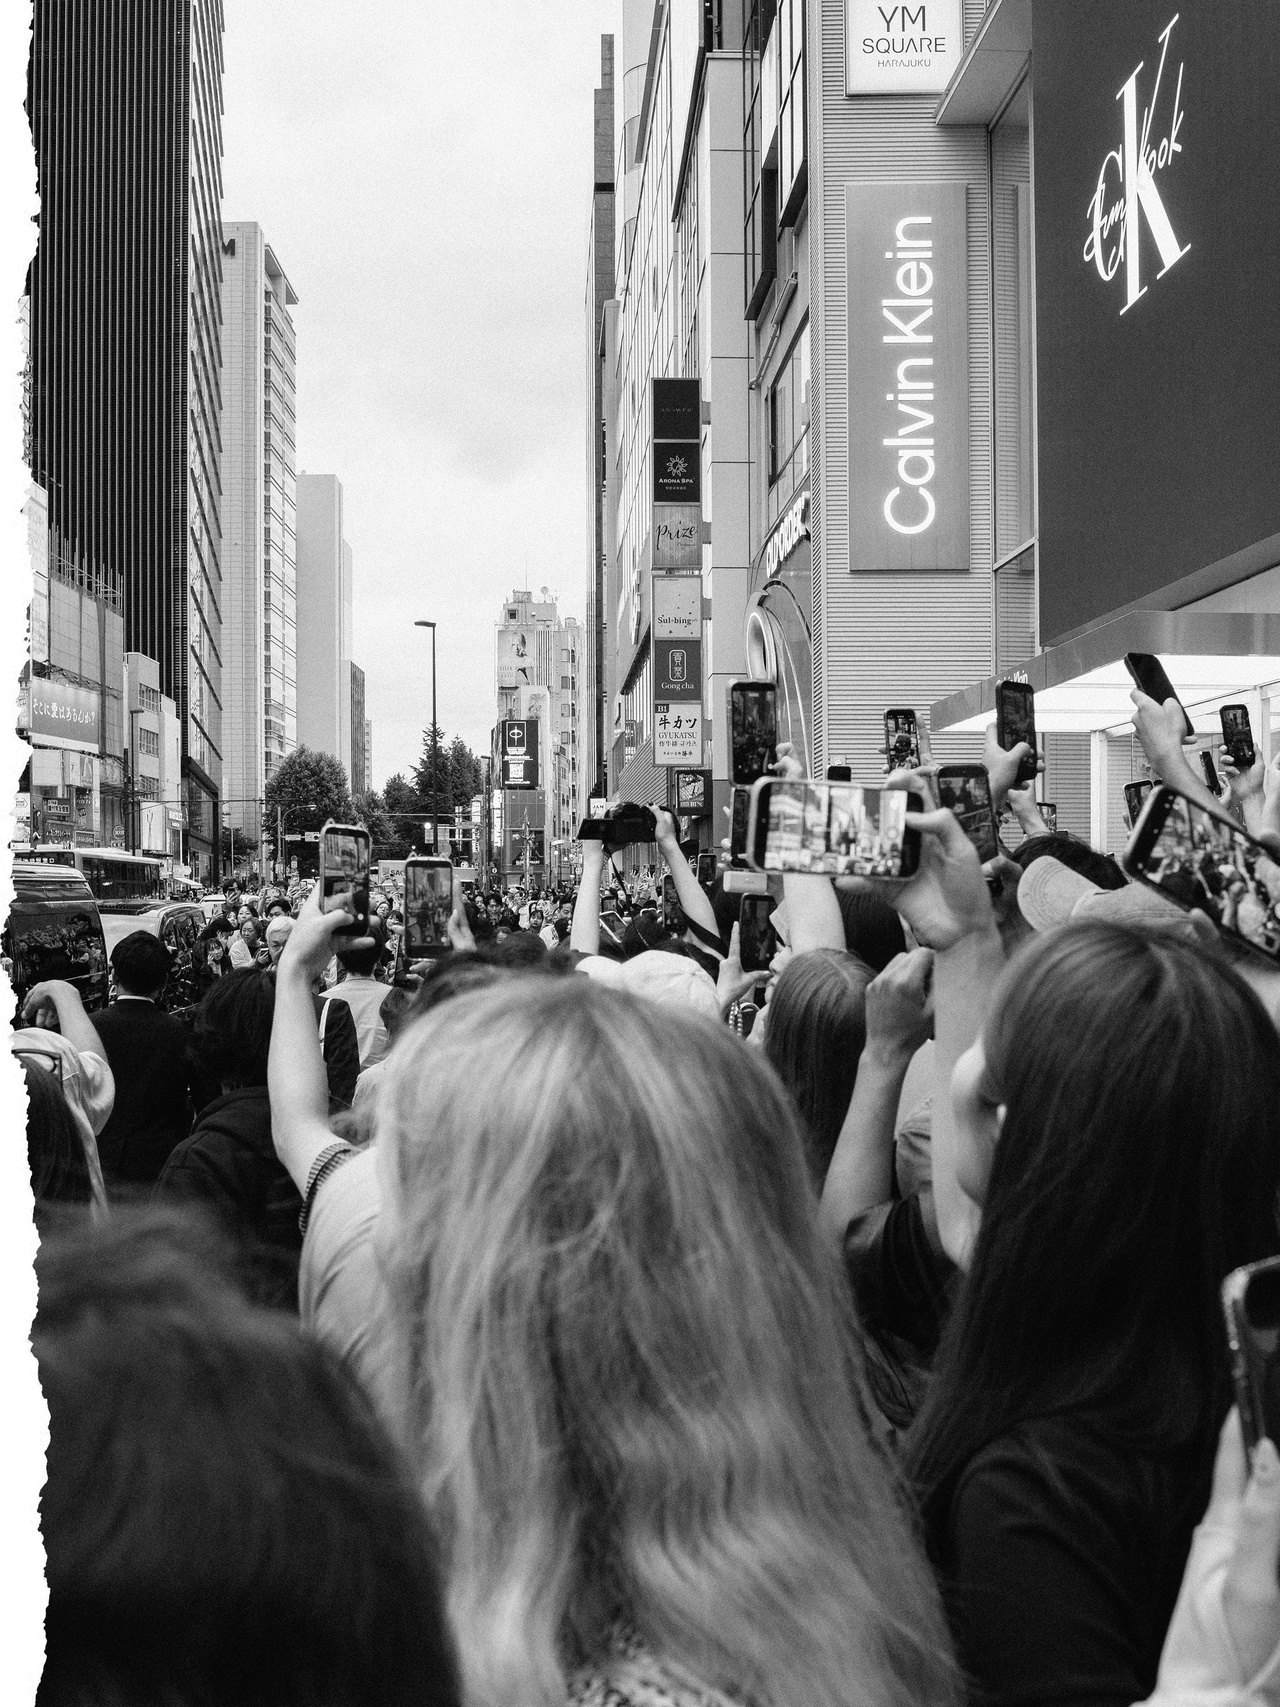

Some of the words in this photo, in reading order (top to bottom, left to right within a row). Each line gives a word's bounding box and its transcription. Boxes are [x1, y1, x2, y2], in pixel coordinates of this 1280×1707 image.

[877, 6, 926, 32] YM
[862, 37, 946, 54] SQUARE
[877, 59, 931, 68] HARAJUKU
[881, 216, 934, 344] Klein
[883, 358, 936, 535] Calvin
[661, 682, 680, 691] Gong
[681, 682, 695, 690] cha
[658, 714, 698, 730] 牛カツ
[658, 731, 698, 739] GYUKATSU
